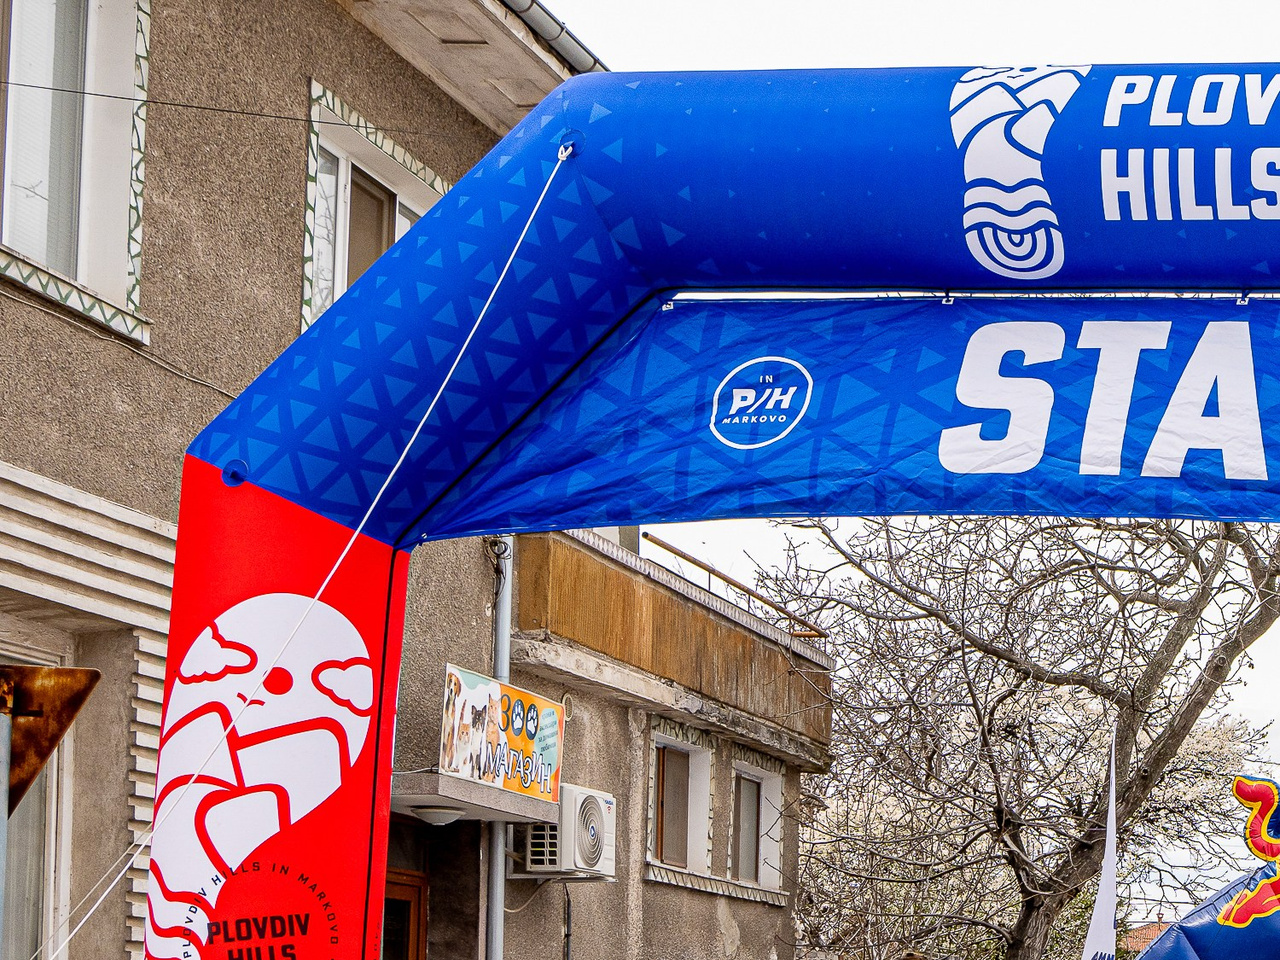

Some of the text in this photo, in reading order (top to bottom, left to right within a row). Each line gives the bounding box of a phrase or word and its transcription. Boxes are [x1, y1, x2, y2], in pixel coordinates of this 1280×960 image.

[760, 375, 773, 383] IN
[729, 386, 797, 415] P/H
[721, 414, 787, 425] MARKOVO
[485, 742, 552, 794] МАГАЗИН
[183, 862, 338, 959] PLOVDIV HILLS IN MARKOVO
[207, 913, 310, 945] PLOVDIV
